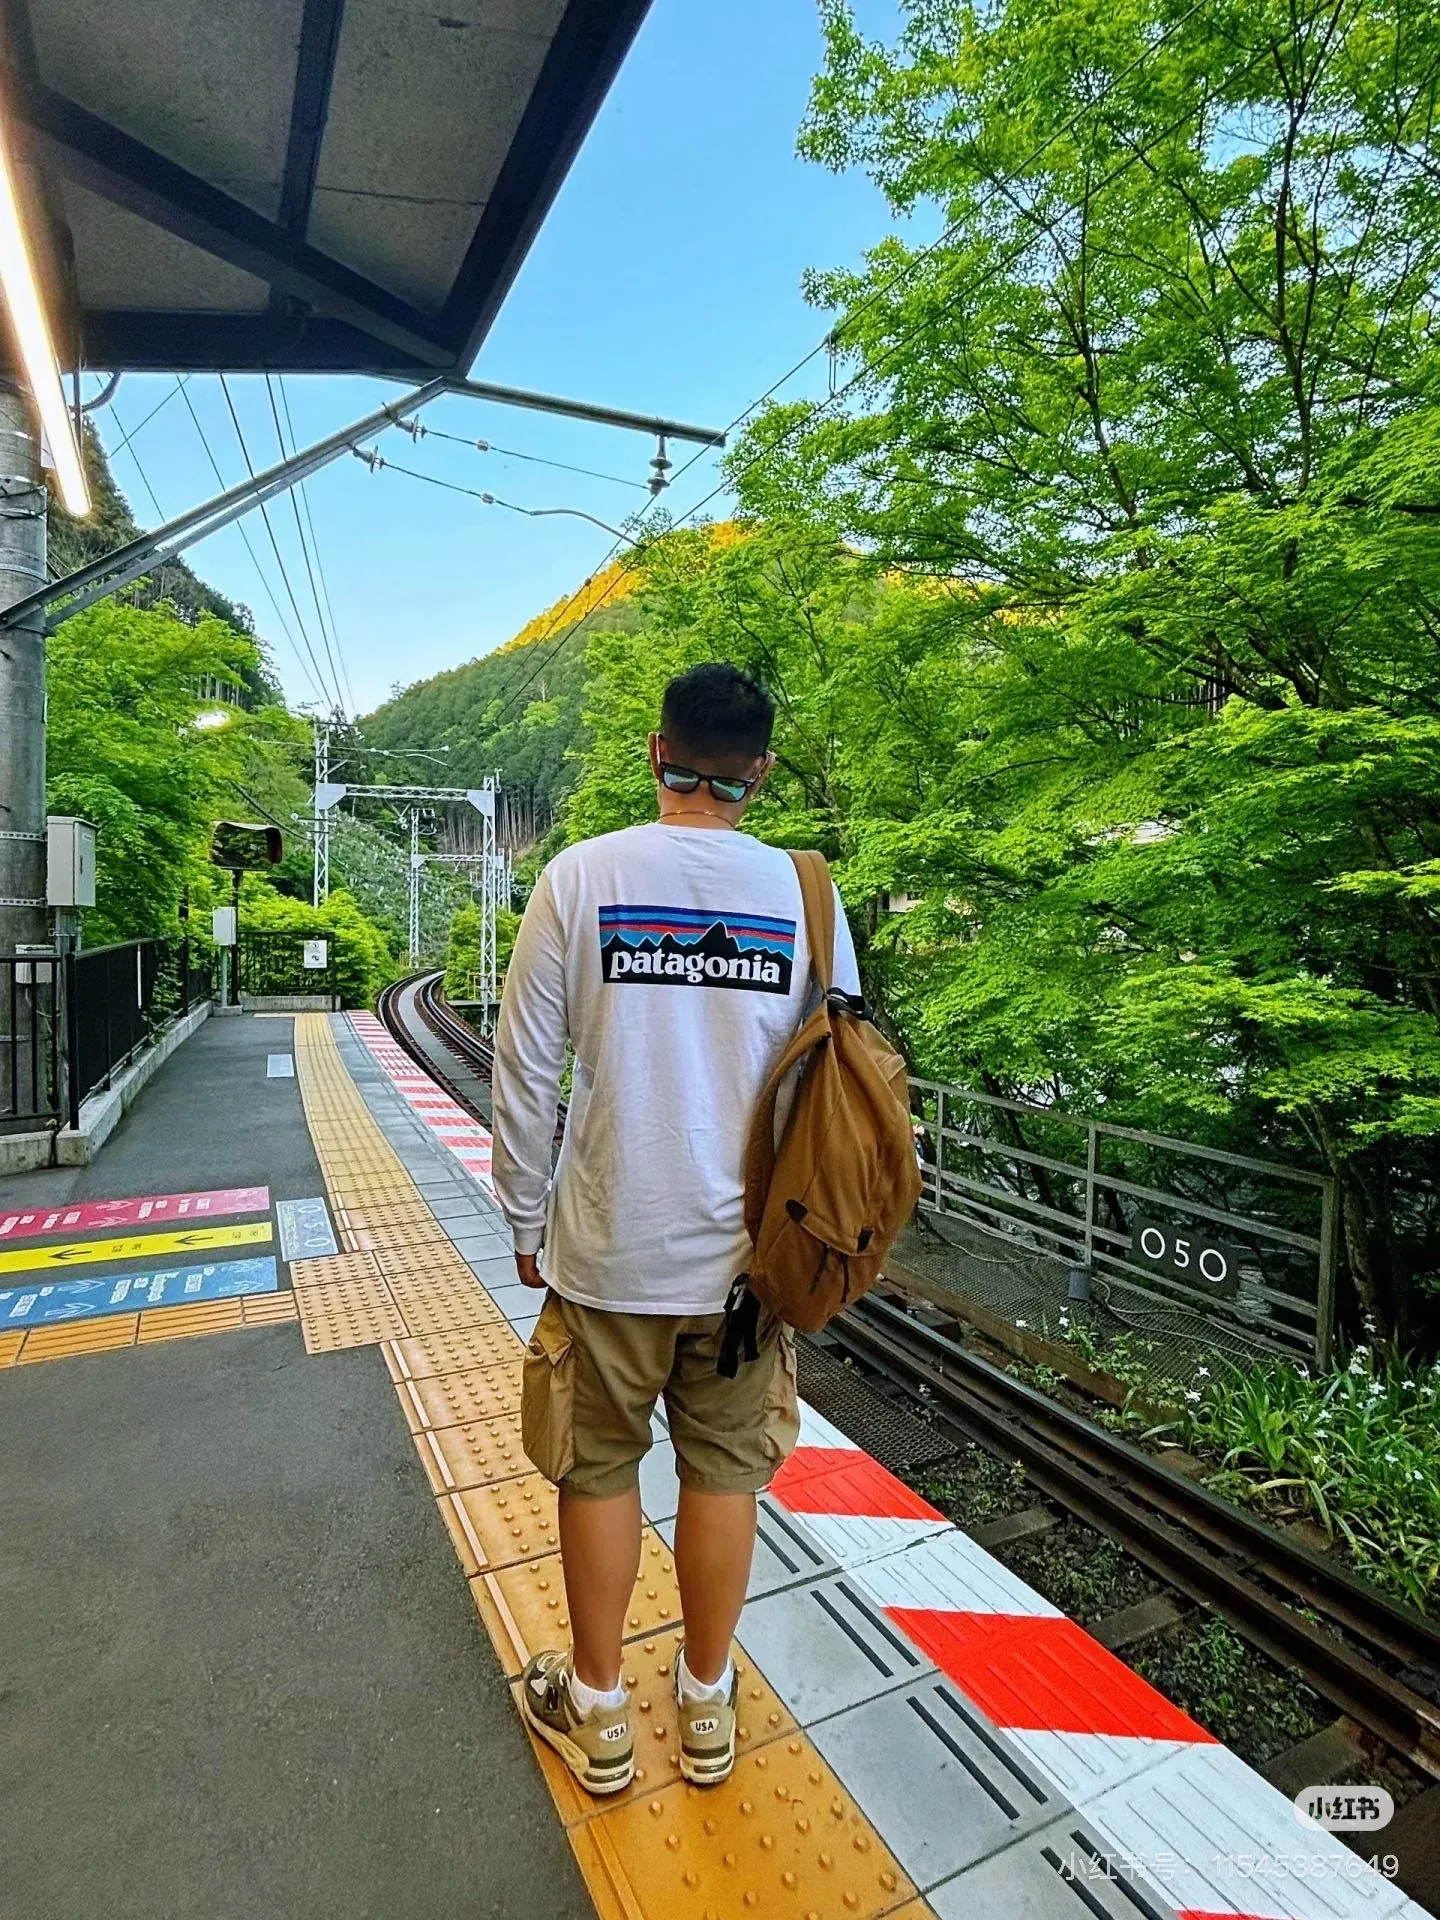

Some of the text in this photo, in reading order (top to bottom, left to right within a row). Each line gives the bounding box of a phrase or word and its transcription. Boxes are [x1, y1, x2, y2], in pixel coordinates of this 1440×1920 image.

[609, 949, 780, 983] patagonia
[607, 1726, 625, 1739] USA
[695, 1721, 714, 1732] USA
